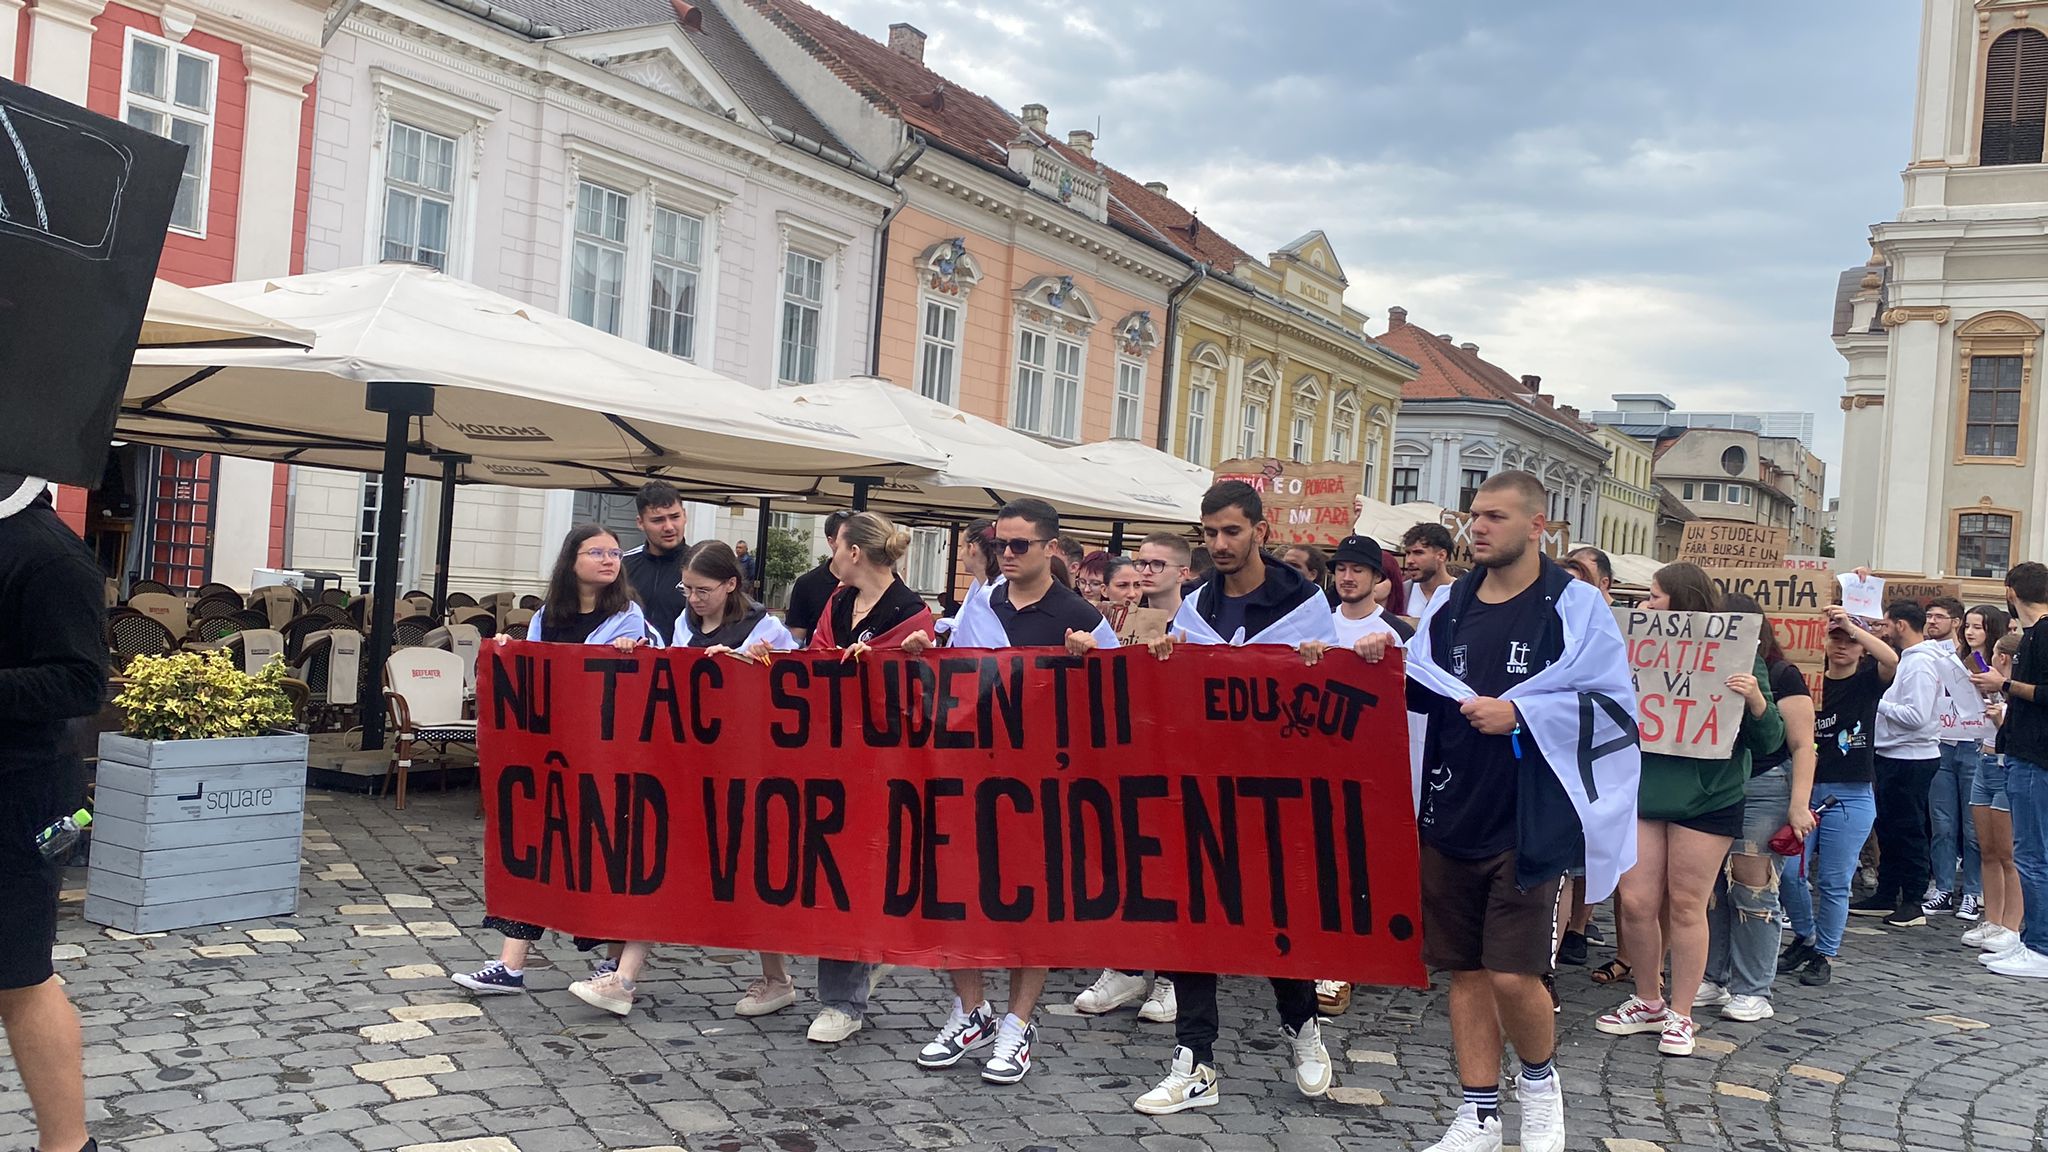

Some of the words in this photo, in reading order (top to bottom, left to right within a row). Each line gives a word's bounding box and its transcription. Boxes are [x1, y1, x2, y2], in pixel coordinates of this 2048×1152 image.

[1289, 479, 1302, 494] O
[1687, 528, 1706, 540] UN
[1710, 526, 1778, 544] STUDENT
[1749, 547, 1757, 558] E
[1760, 549, 1779, 561] UN
[1628, 613, 1693, 639] PASĂ
[1704, 615, 1744, 641] DE
[1506, 665, 1528, 675] UM
[1664, 671, 1694, 697] VĂ
[493, 655, 551, 735] NU
[583, 657, 724, 745] TAC
[770, 656, 1133, 771] STUDENȚII
[1638, 693, 1723, 746] STĂ
[207, 788, 273, 815] square
[497, 751, 669, 896] CÂND
[702, 775, 850, 912] VOR
[883, 774, 1414, 957] DECIDENȚII.
